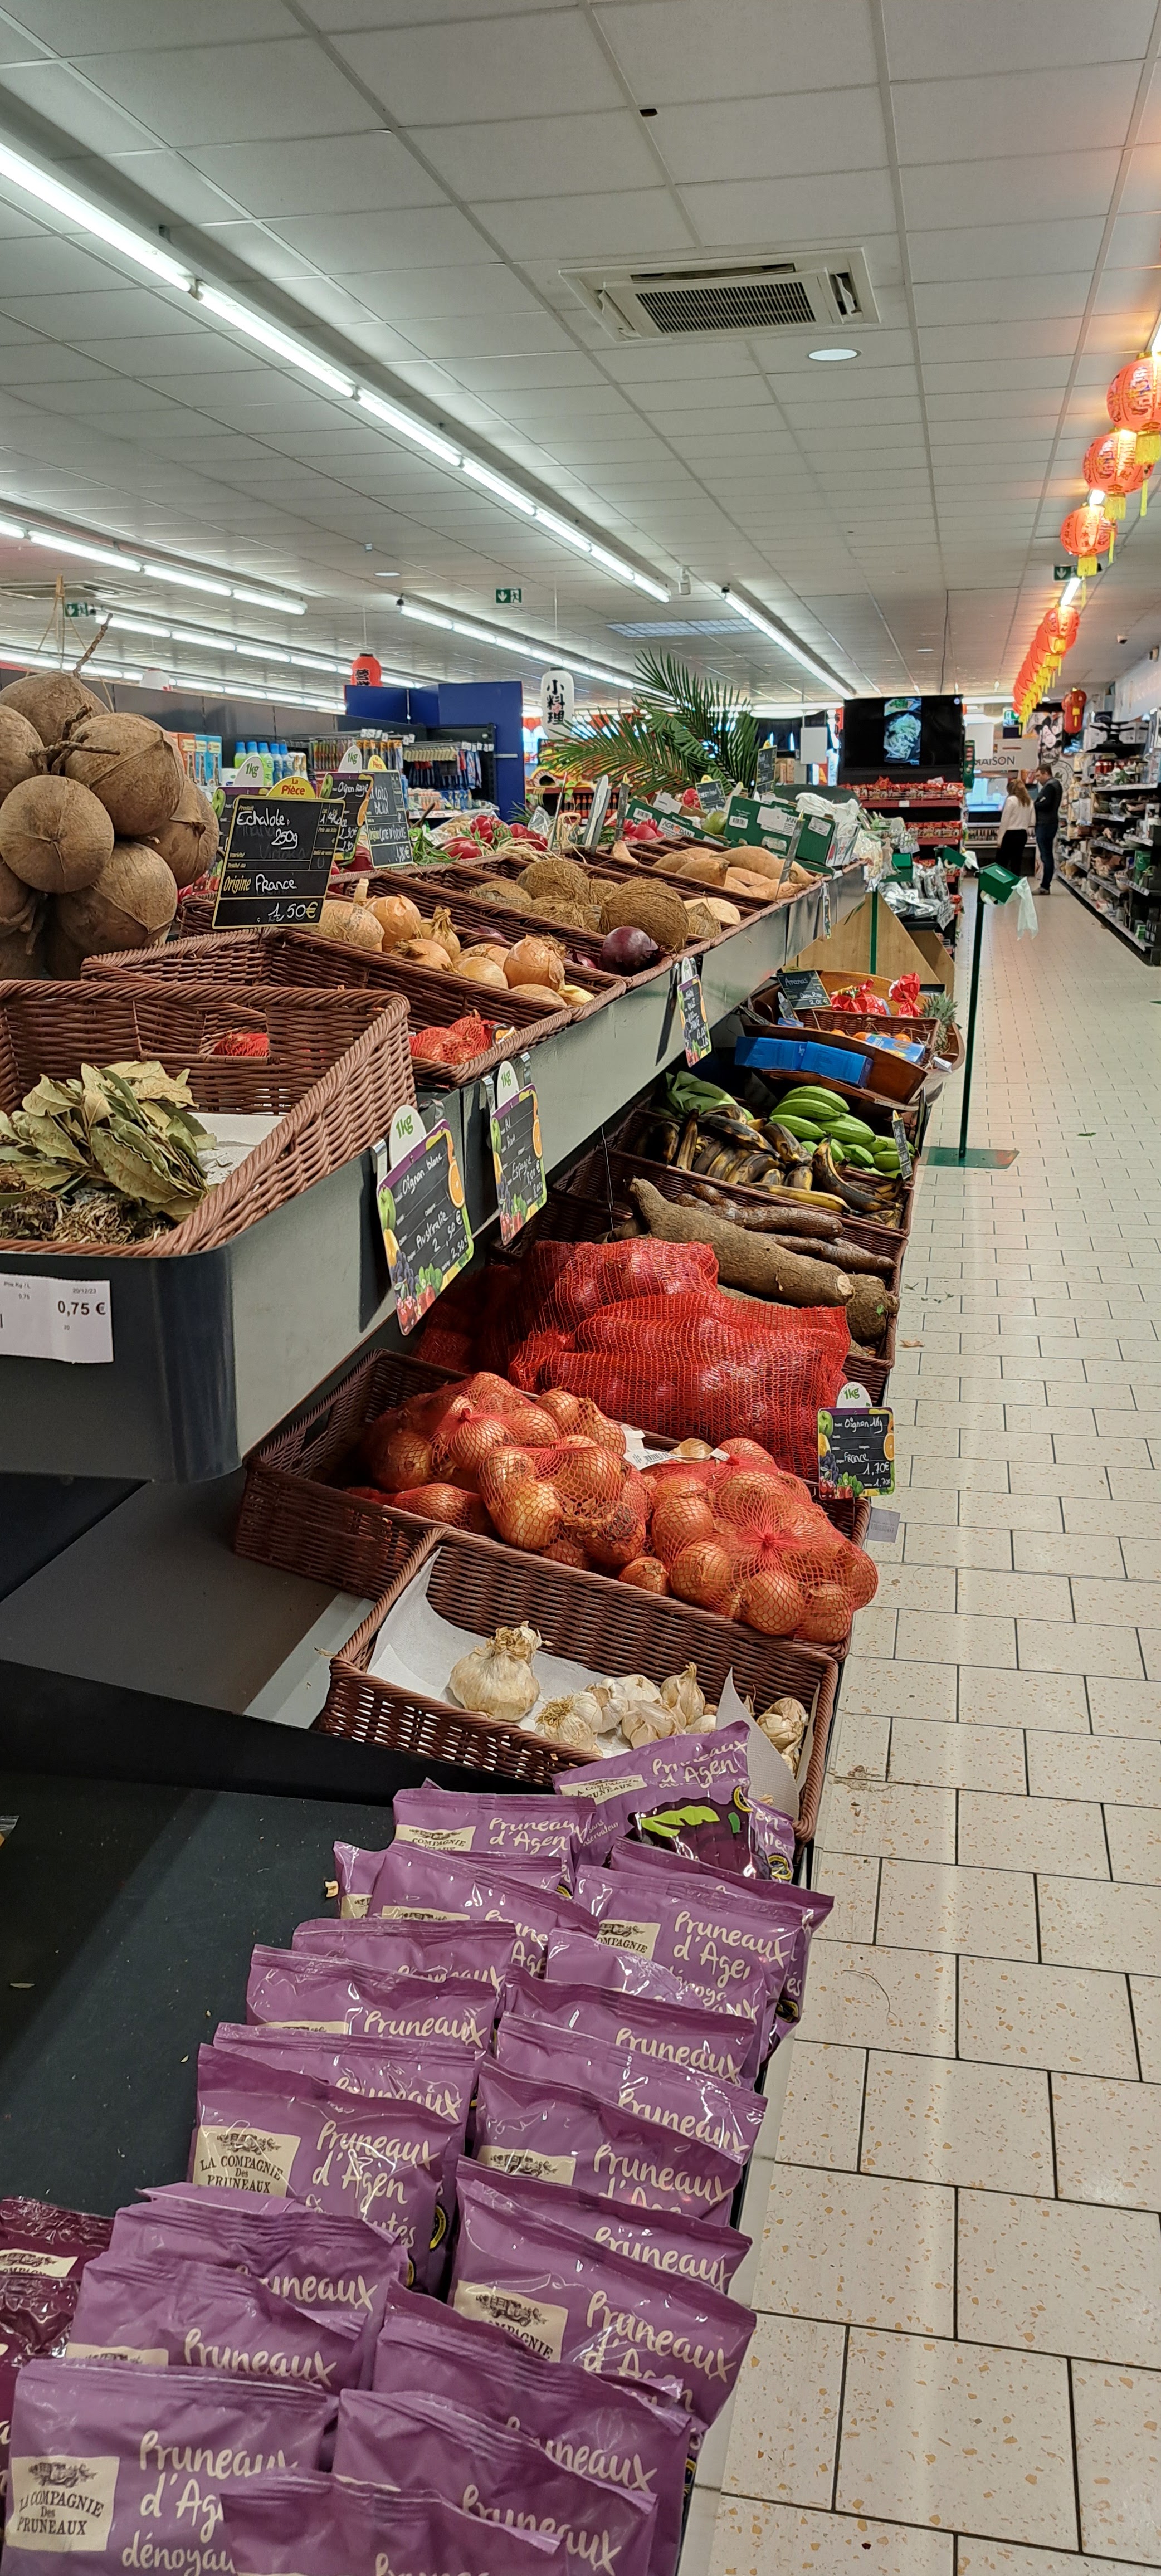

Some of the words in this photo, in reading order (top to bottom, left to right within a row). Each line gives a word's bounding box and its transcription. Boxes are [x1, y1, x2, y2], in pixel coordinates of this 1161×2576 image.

[547, 679, 565, 725] 小料理
[246, 763, 260, 778] 1kg
[348, 753, 358, 765] 1kg
[281, 785, 305, 796] Pièce
[271, 829, 297, 850] 250g
[223, 875, 251, 894] Origine
[256, 874, 297, 892] France
[501, 1070, 511, 1088] 1kg
[396, 1114, 413, 1139] 1kg
[402, 1169, 425, 1194] Oignon
[426, 1152, 442, 1170] blanc
[416, 1210, 449, 1249] Australie
[58, 1300, 90, 1317] 0,75
[96, 1302, 106, 1315] €
[844, 1388, 860, 1400] 1kg
[845, 1417, 869, 1433] Oignon
[582, 1822, 620, 1846] nservateur
[588, 1819, 605, 1834] sans
[412, 1837, 467, 1847] COMPAGNIE
[490, 1831, 569, 1855] d'Agen
[674, 1910, 790, 1968] Pruneaux
[364, 2010, 487, 2048] Pruneaux
[615, 2028, 742, 2083] Pruneaux
[618, 2091, 750, 2154] Pruneaux
[316, 2120, 440, 2170] Pruneaux
[200, 2157, 216, 2172] LA
[221, 2155, 284, 2182] COMPAGNIE
[235, 2168, 249, 2178] Des
[593, 2143, 734, 2206] Pruneaux
[207, 2174, 271, 2194] PRUNEAUX
[313, 2151, 408, 2218] d'Agen
[594, 2226, 731, 2291] Pruneaux
[586, 2290, 736, 2384] Pruneaux
[184, 2328, 337, 2387] Pruneaux
[30, 2491, 104, 2518] COMPAGNIE
[41, 2506, 55, 2518] Des
[141, 2472, 223, 2544] d'Ag
[17, 2519, 87, 2535] PRUNEAUX
[122, 2530, 236, 2576] dénoyau
